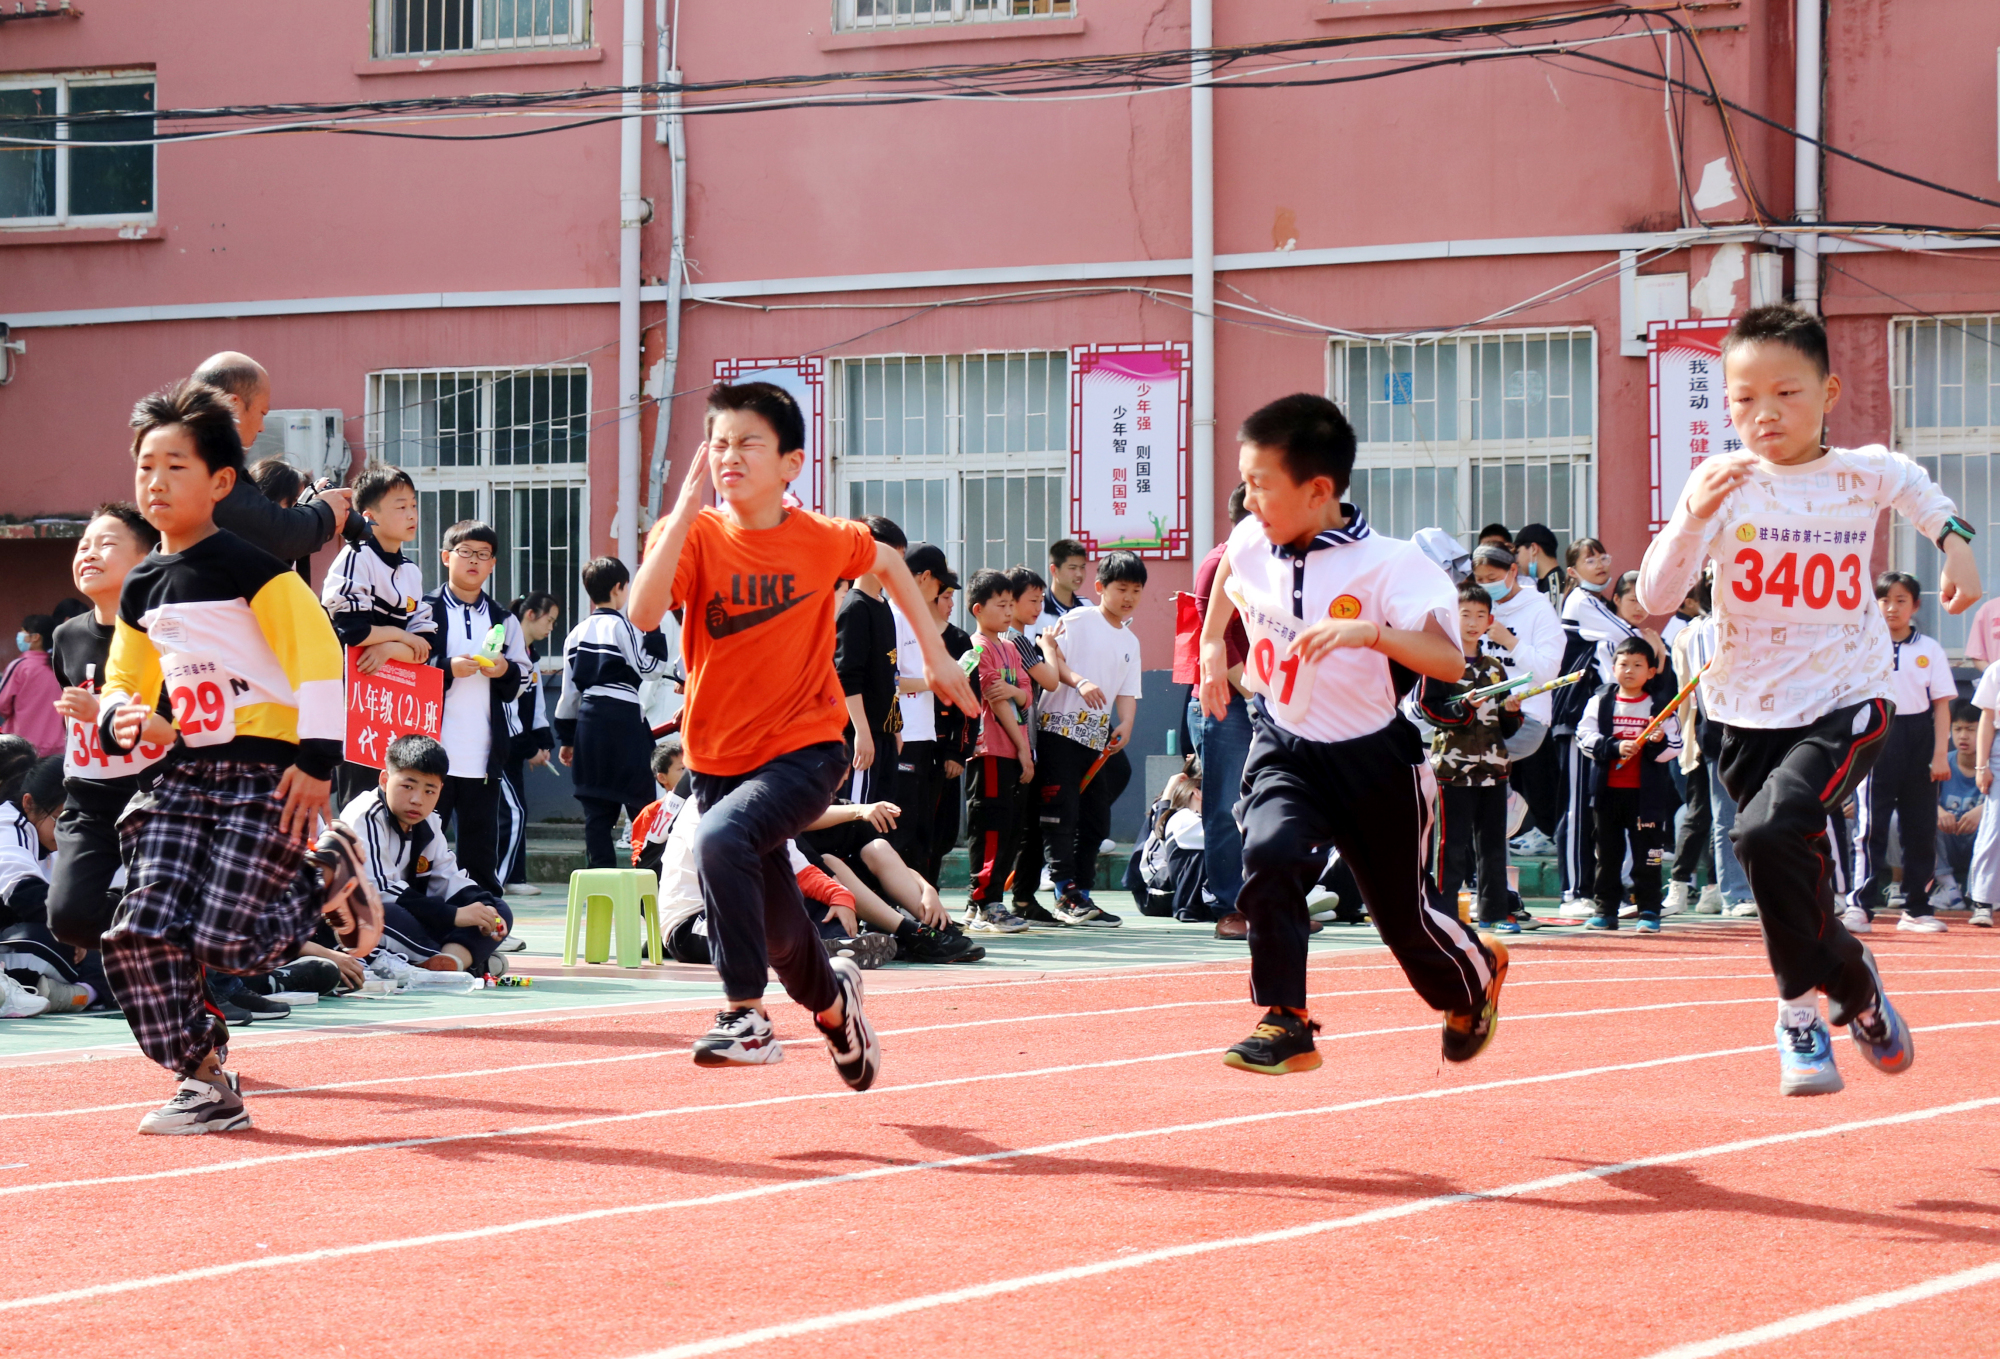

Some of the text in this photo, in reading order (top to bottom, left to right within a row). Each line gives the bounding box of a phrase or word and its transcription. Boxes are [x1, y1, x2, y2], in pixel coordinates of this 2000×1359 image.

[1689, 359, 1709, 410] 我运动
[1112, 405, 1127, 516] 少年智 则国智
[1136, 382, 1151, 493] 少年强 则国强
[1759, 527, 1867, 544] 驻马店市第十二初级中学
[732, 574, 795, 607] LIKE
[1731, 548, 1862, 611] 3403
[170, 681, 225, 736] 29
